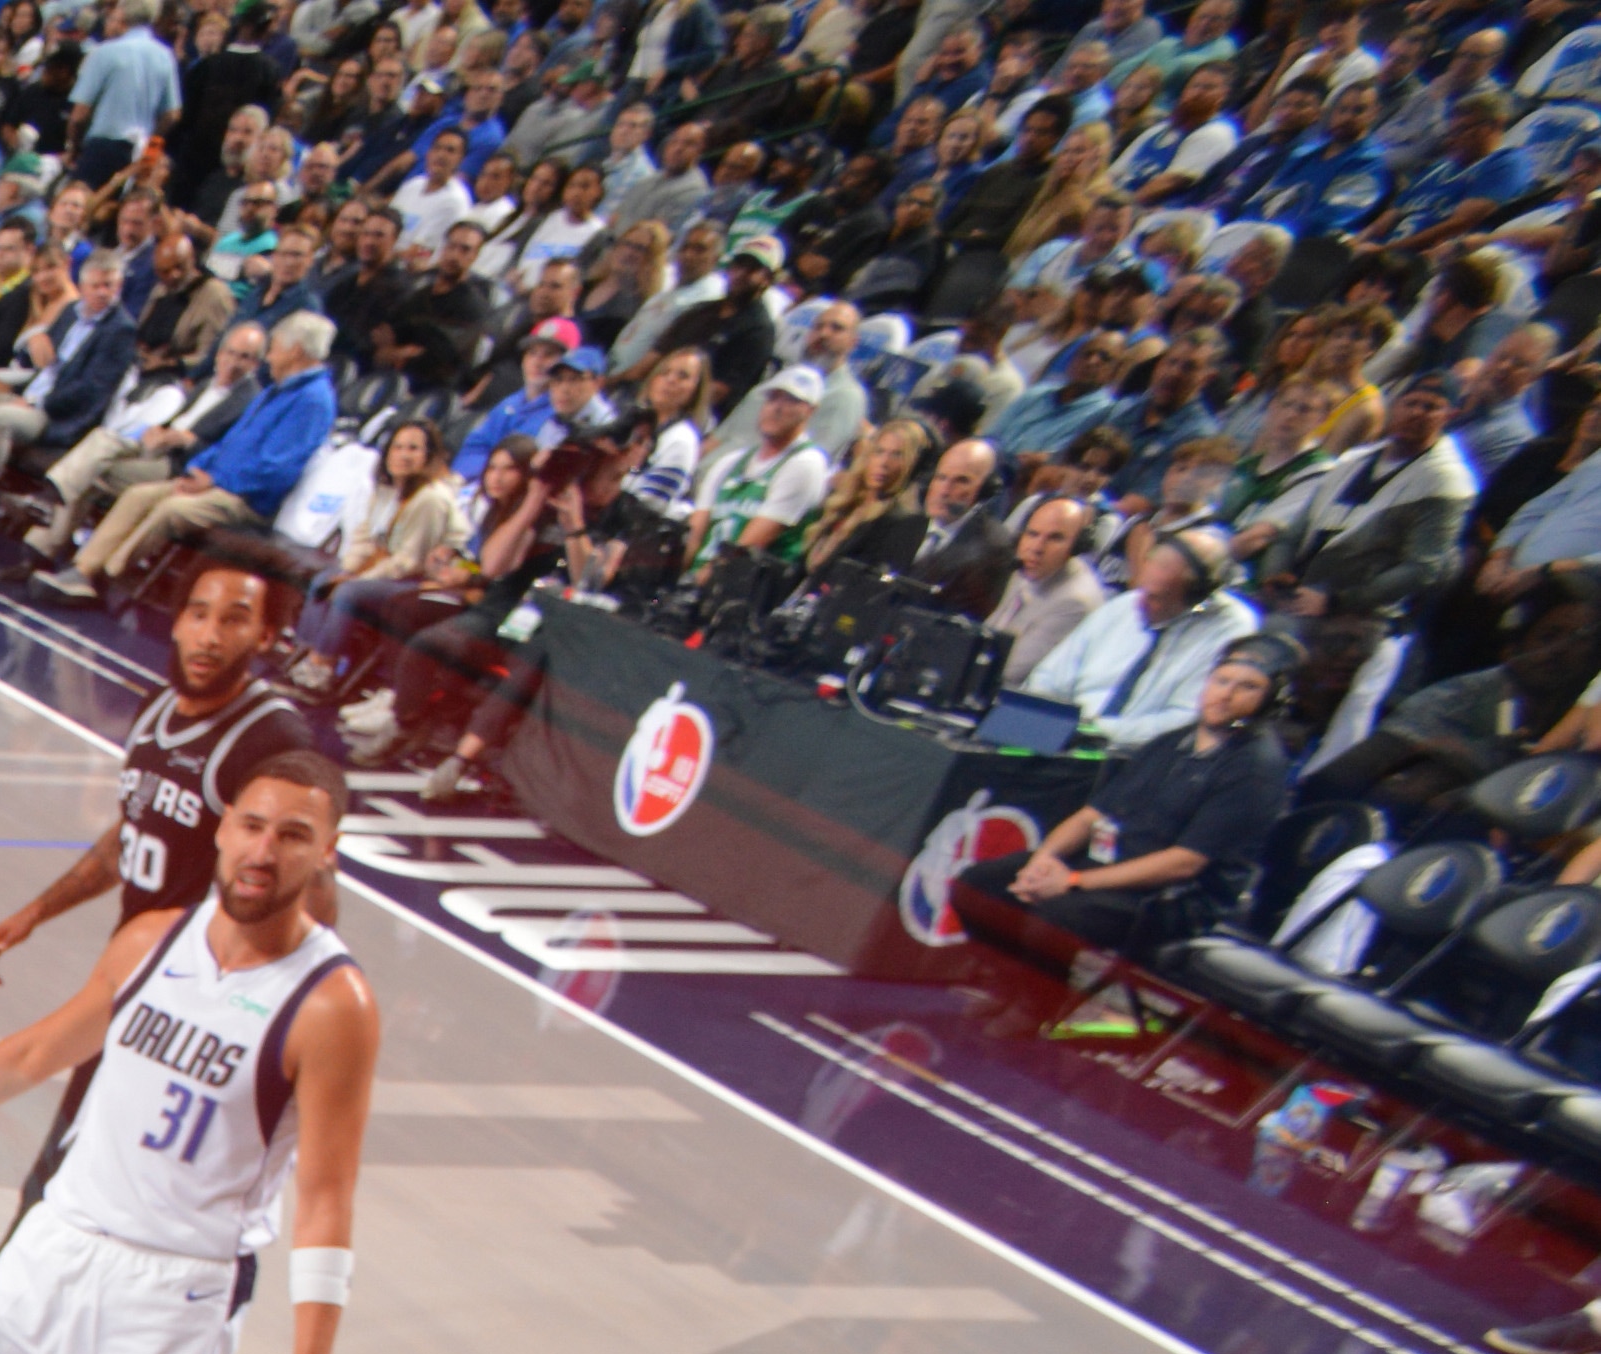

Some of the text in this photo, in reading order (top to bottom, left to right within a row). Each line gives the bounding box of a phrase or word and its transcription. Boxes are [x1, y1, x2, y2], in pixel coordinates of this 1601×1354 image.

[118, 822, 168, 893] 30
[117, 1001, 249, 1089] DALLAS
[139, 1080, 219, 1167] 31
